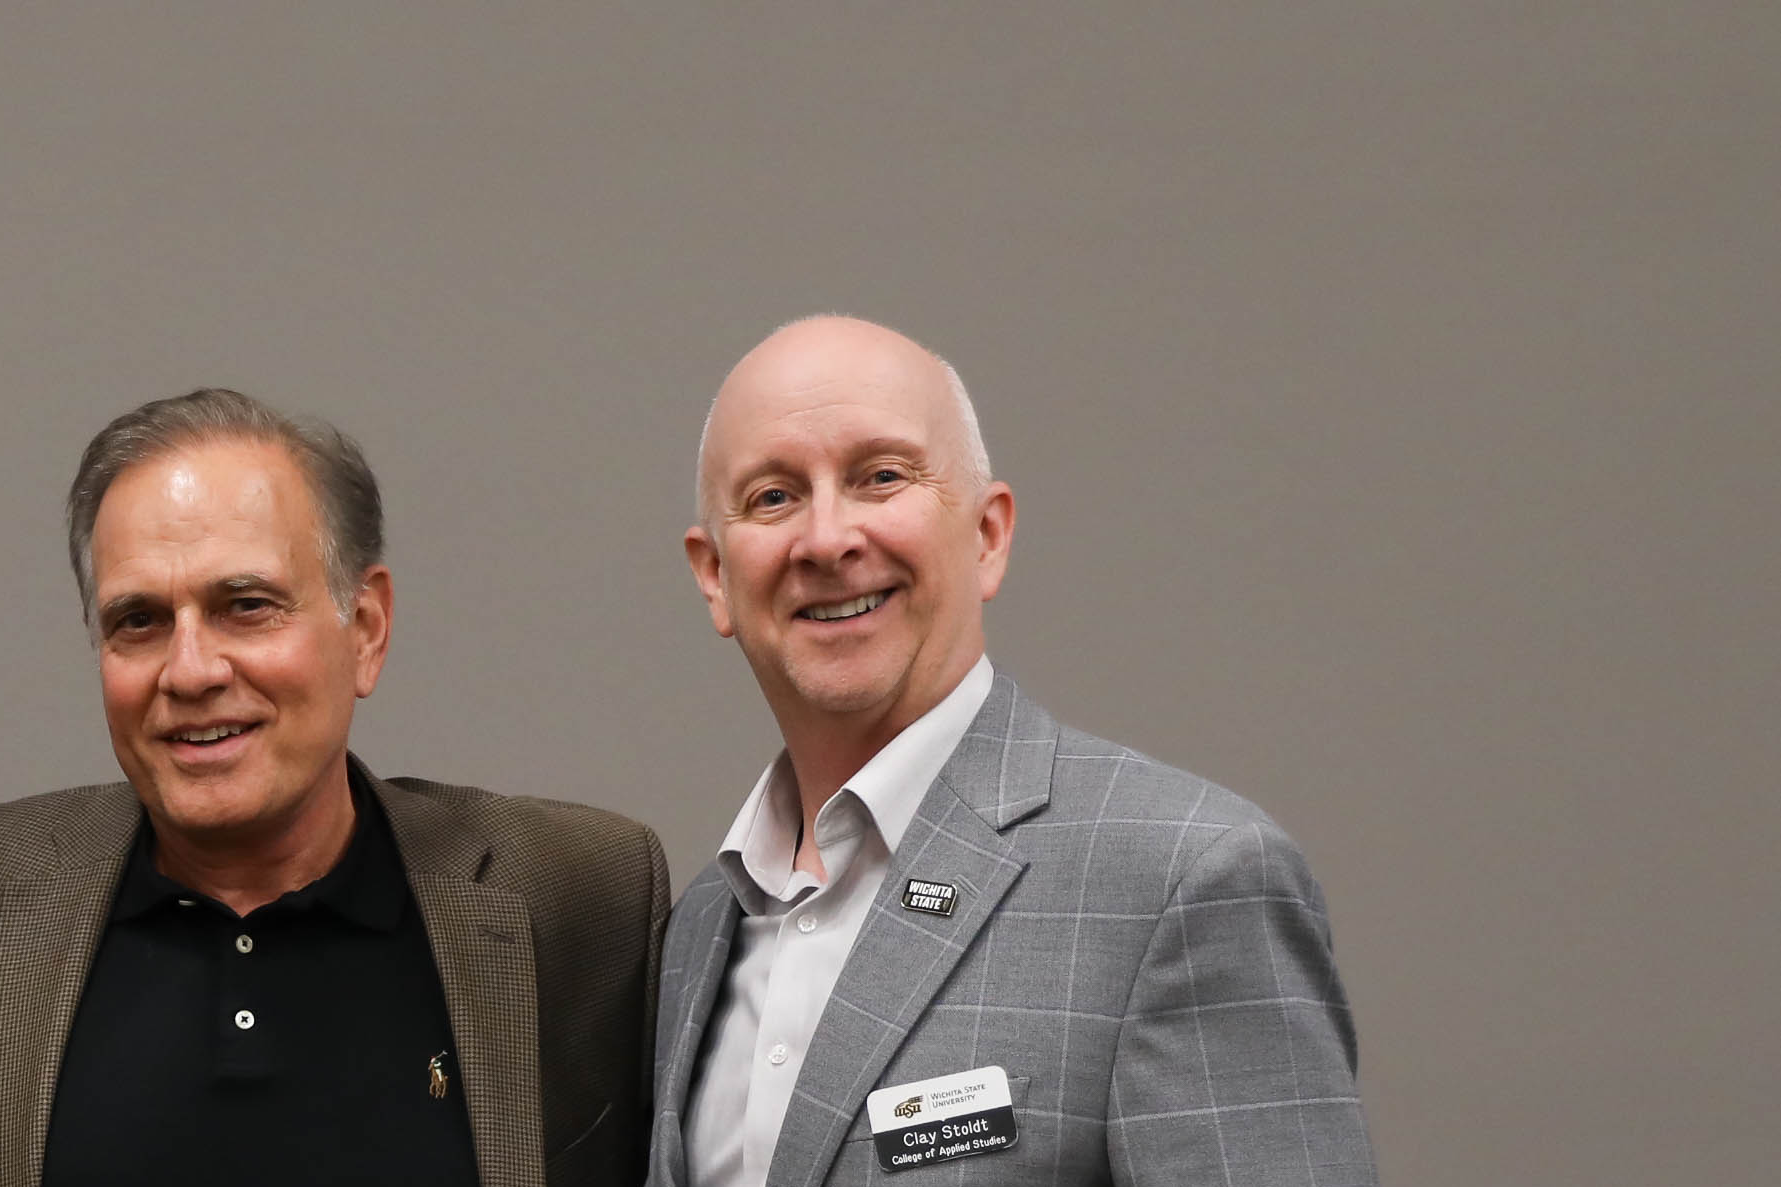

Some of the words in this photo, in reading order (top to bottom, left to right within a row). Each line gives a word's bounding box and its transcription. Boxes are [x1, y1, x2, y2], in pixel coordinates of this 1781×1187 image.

[909, 881, 953, 898] WICHITA
[910, 895, 942, 910] STATE
[903, 1131, 937, 1147] Clay
[941, 1118, 989, 1139] Stoldt
[892, 1152, 923, 1165] College
[926, 1148, 936, 1159] of
[939, 1142, 970, 1157] Applied
[973, 1134, 1006, 1149] Studies
